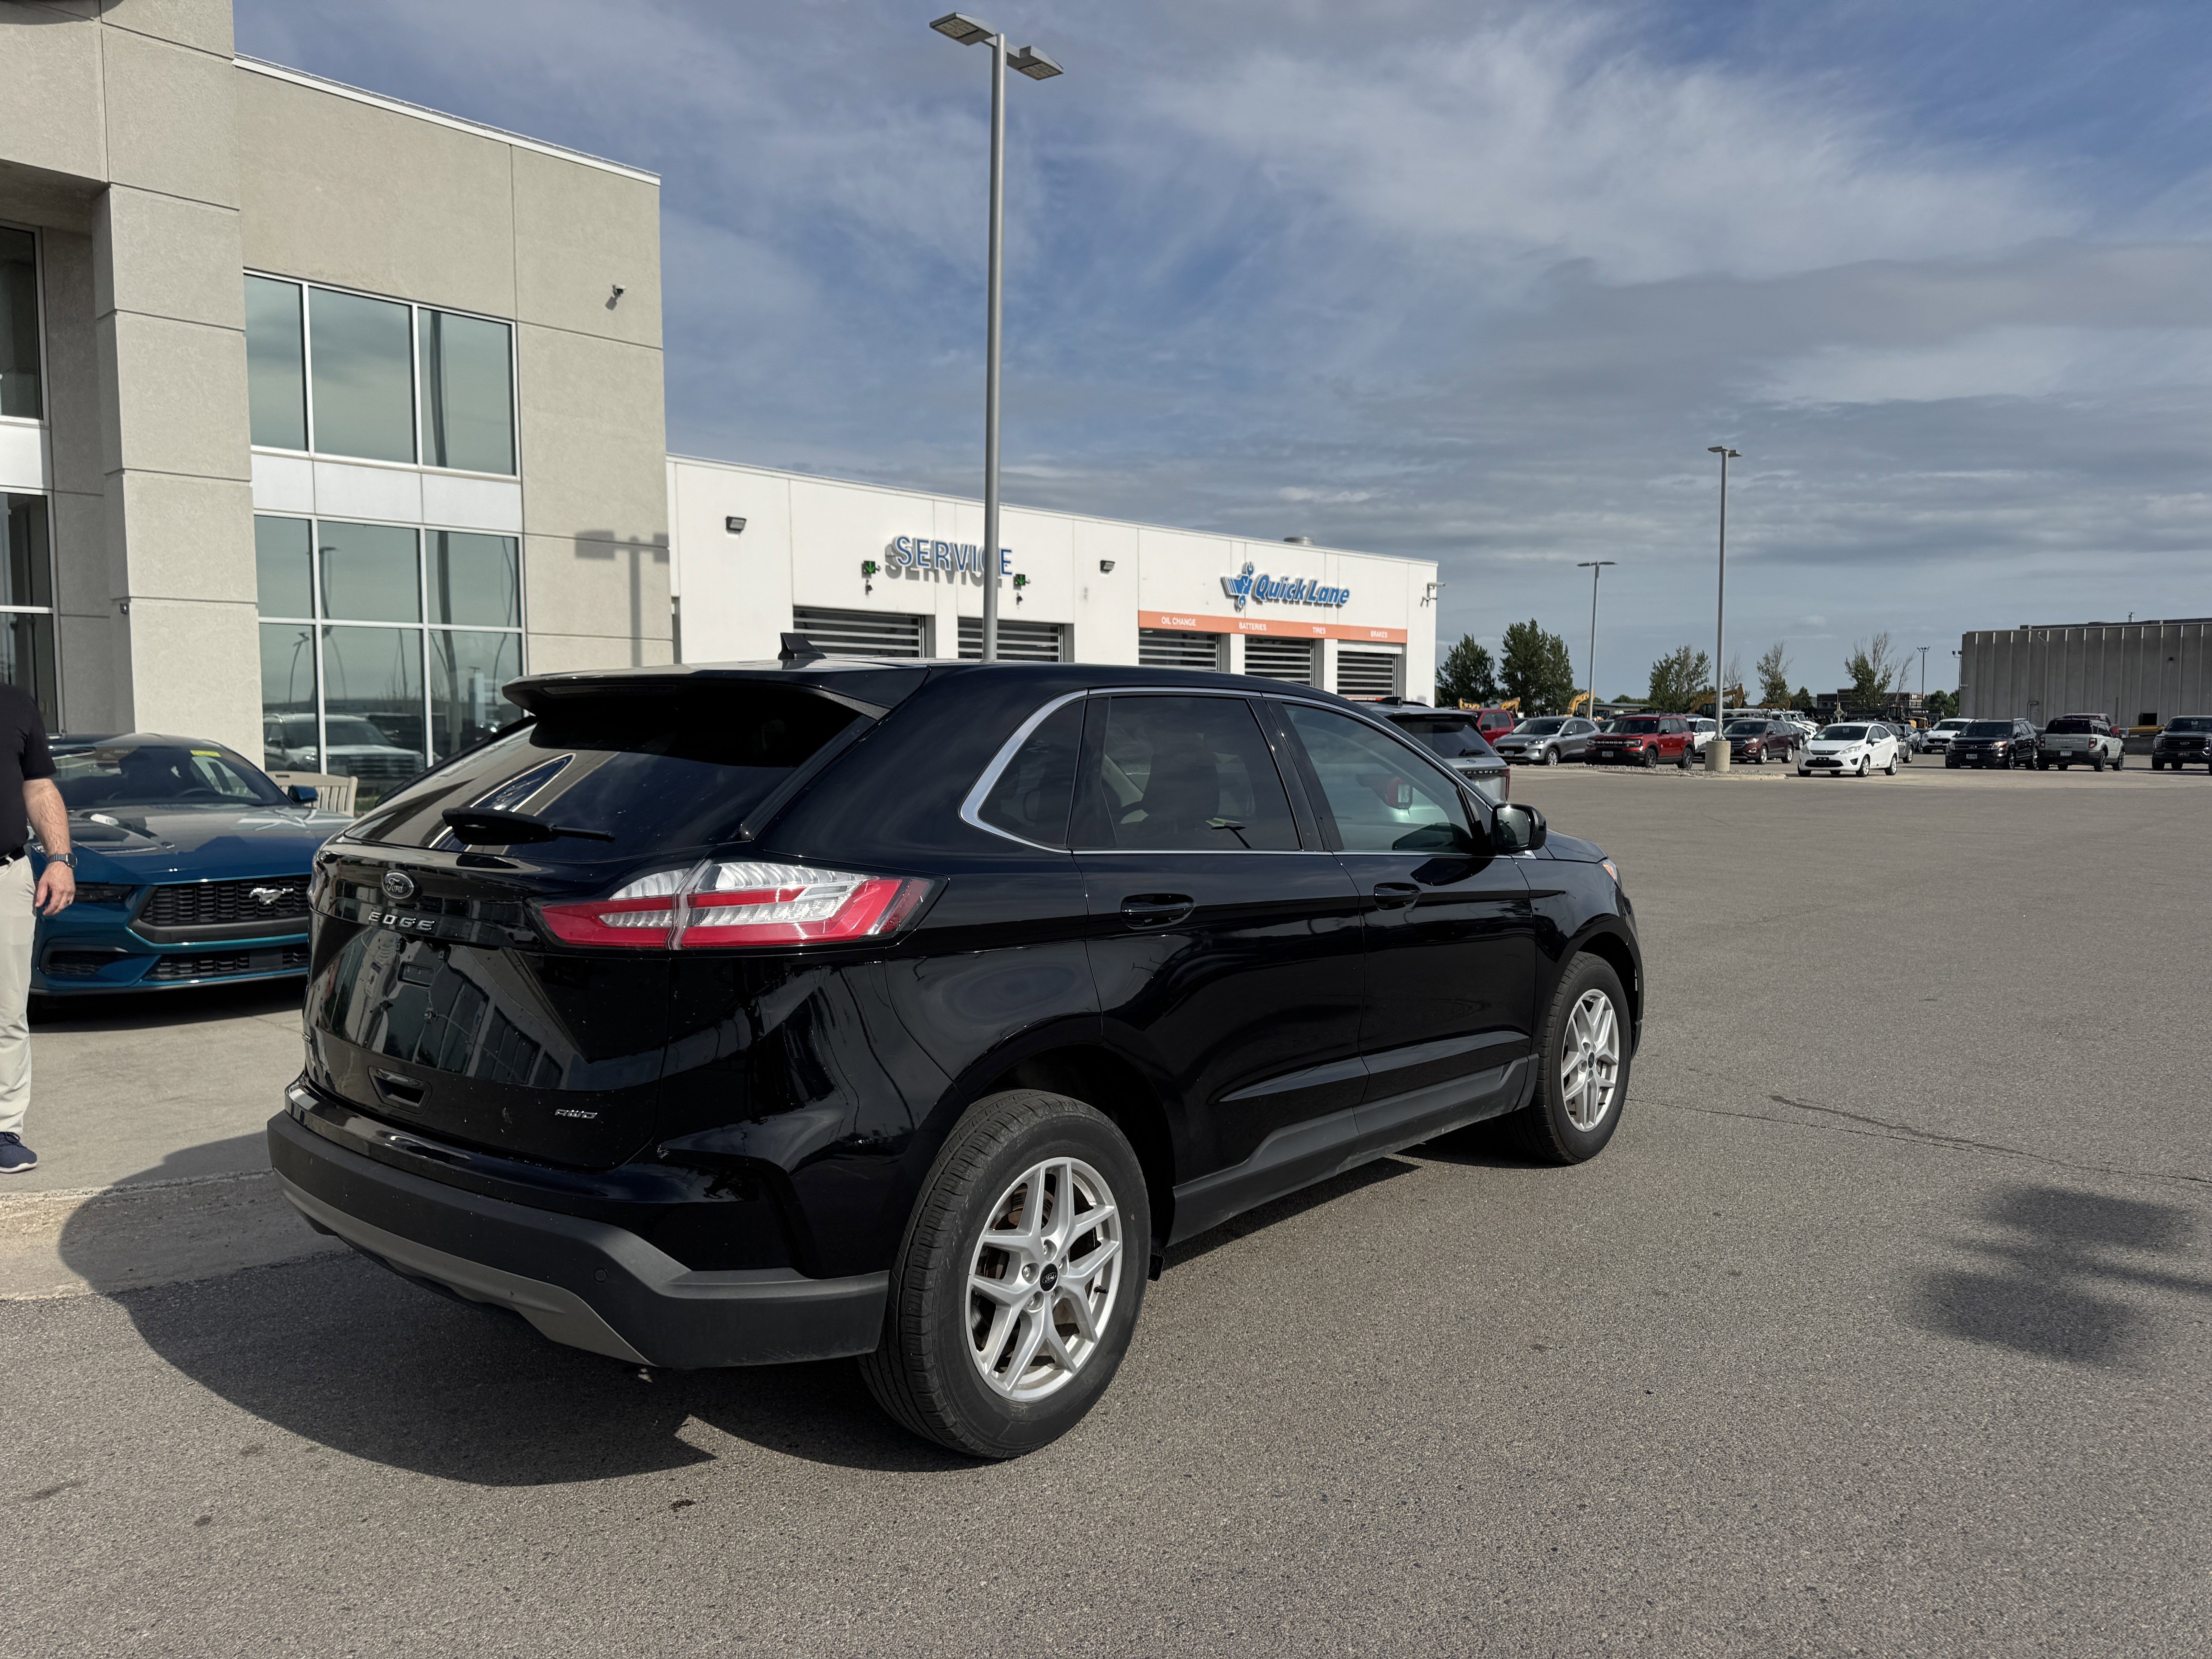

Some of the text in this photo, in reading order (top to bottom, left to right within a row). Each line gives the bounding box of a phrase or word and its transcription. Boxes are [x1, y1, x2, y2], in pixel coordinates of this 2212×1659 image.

[895, 536, 1013, 576] SERVIE
[1255, 574, 1350, 606] Quick Lane
[1161, 617, 1196, 626] OIL CHANGE
[1239, 622, 1267, 631] BATTERIES
[1370, 630, 1388, 638] BRAKES
[387, 878, 404, 893] Ford
[368, 911, 434, 931] EDGE
[555, 1109, 598, 1119] AWD
